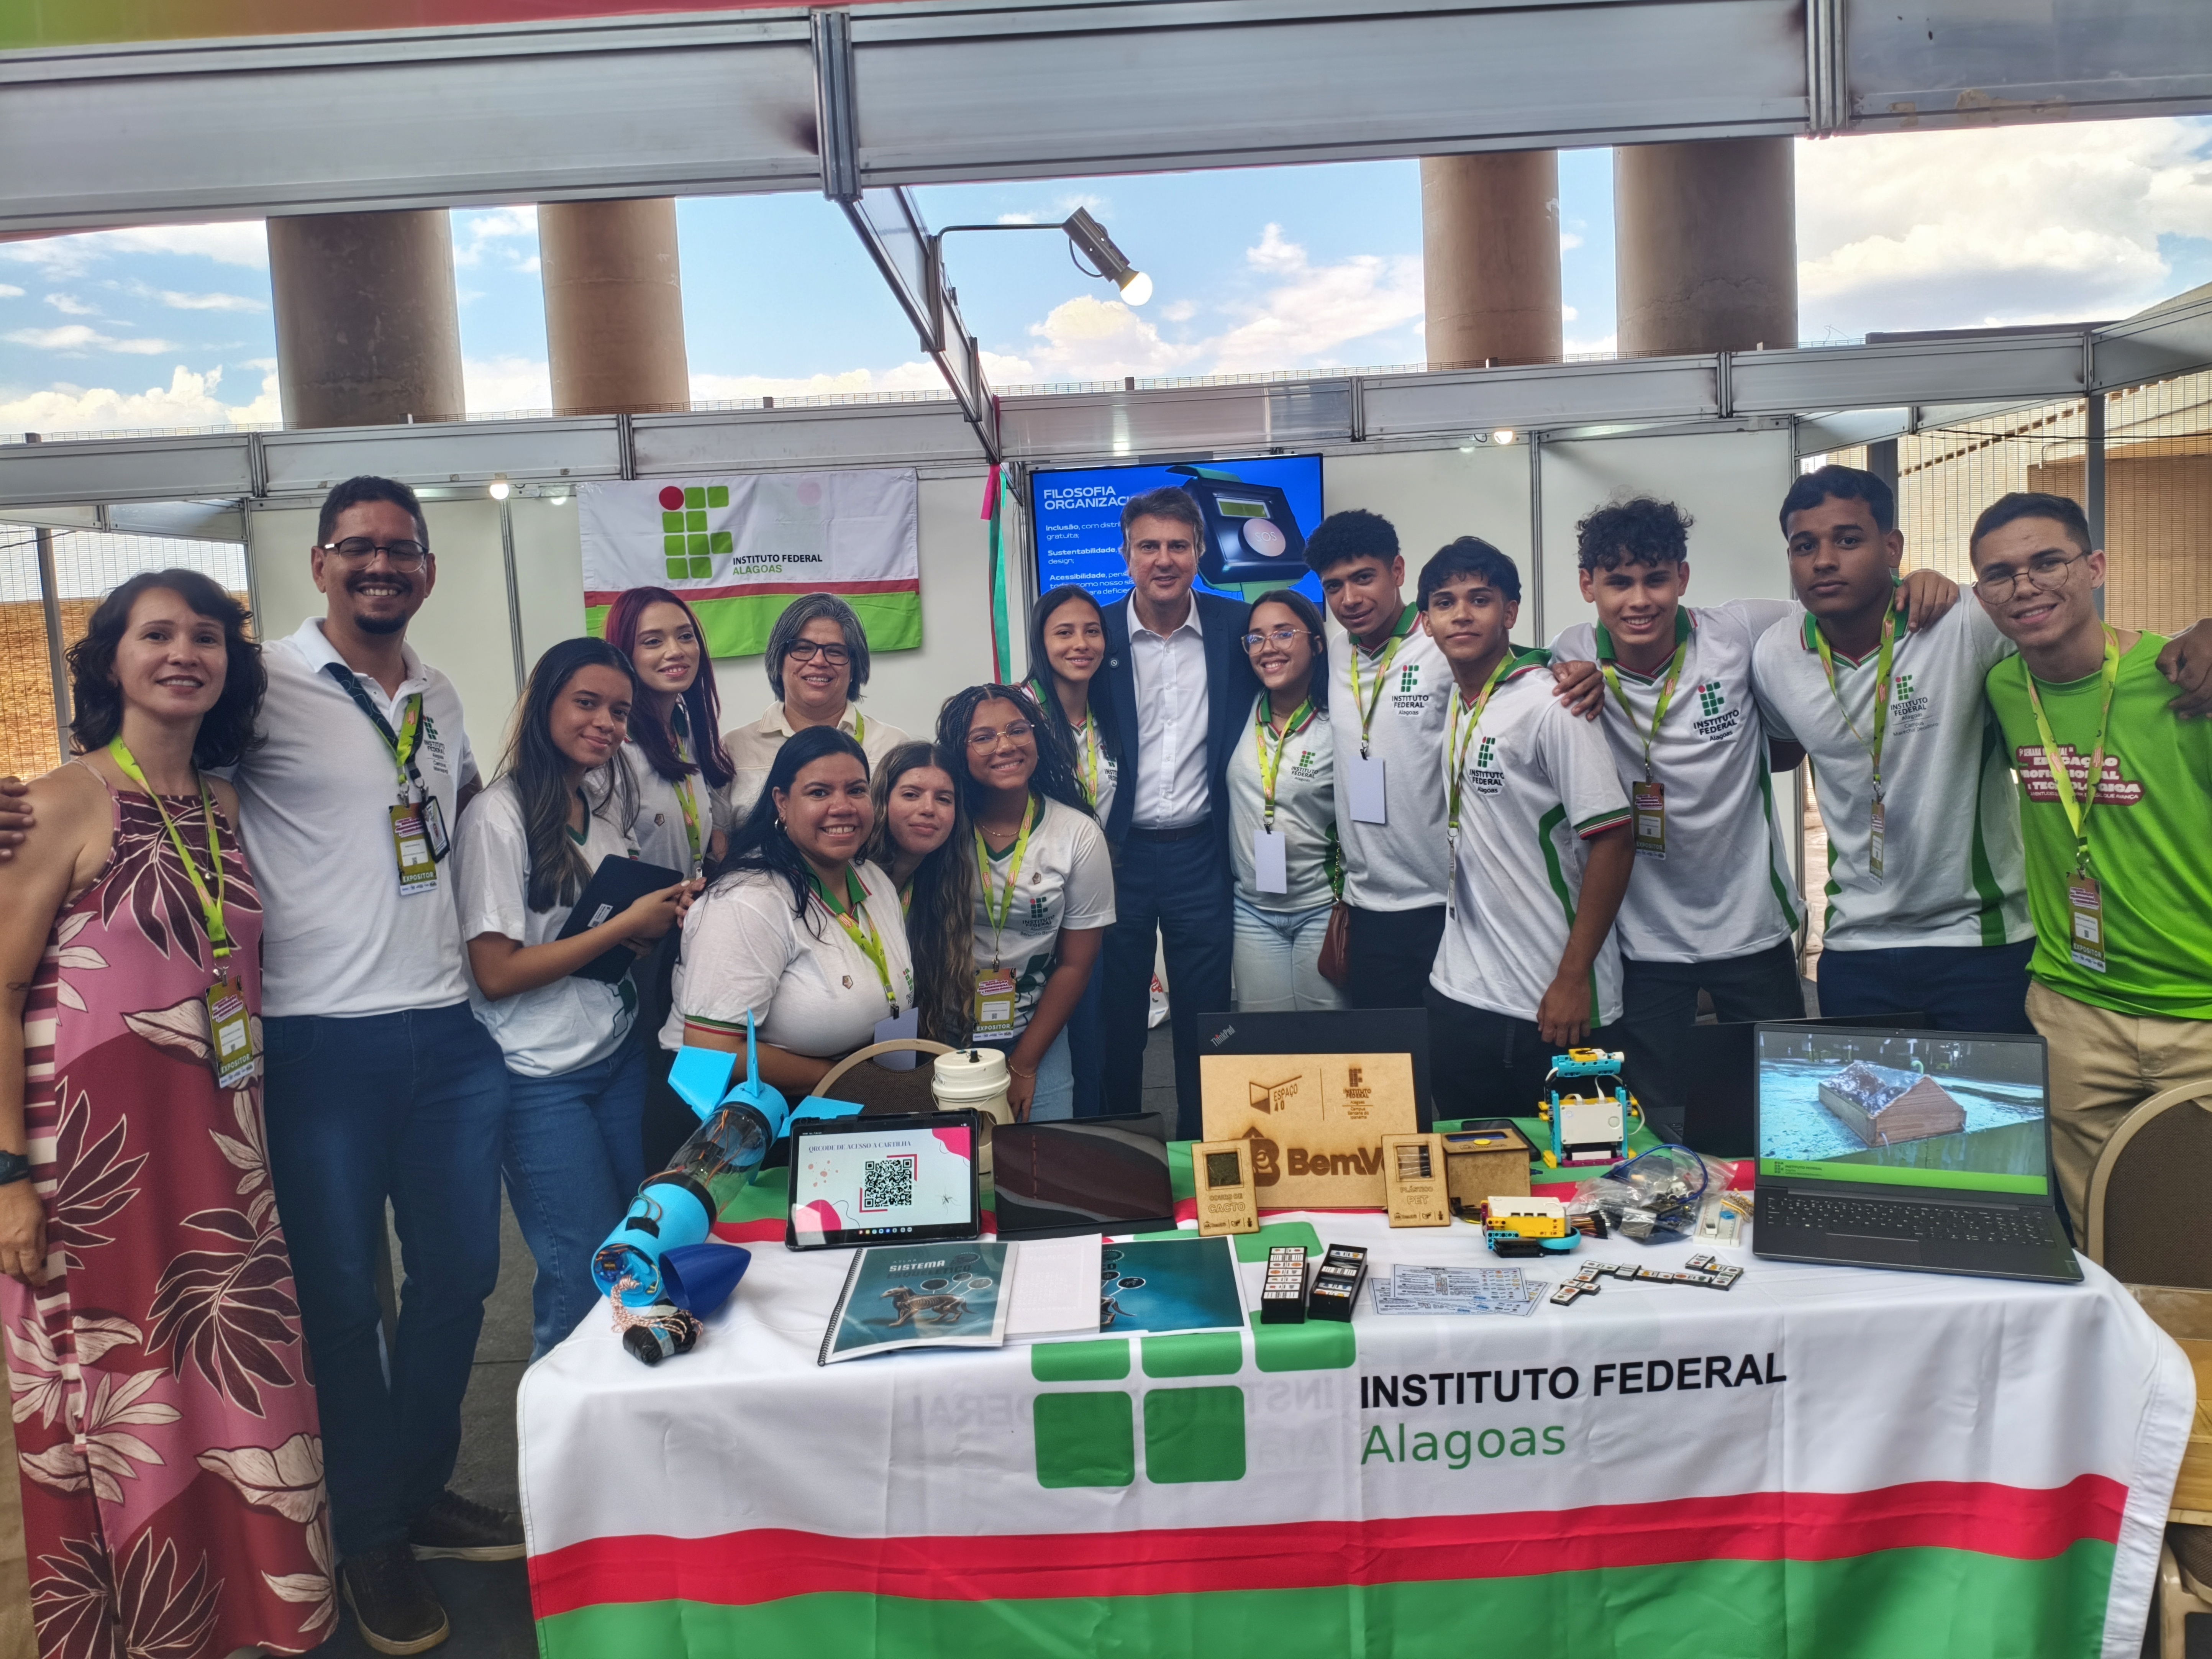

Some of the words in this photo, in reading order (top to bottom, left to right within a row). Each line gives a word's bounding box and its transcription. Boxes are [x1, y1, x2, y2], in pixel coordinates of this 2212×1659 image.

[1044, 486, 1116, 499] FILOSOFIA
[1255, 532, 1277, 542] SOS
[1048, 547, 1117, 556] Sustentabilidade,
[733, 554, 780, 565] INSTITUTO
[733, 565, 782, 575] ALAGOAS
[1049, 572, 1107, 581] Acessibilidade,
[1891, 697, 1928, 710] INSTITUTO
[1894, 704, 1927, 716] FEDERAL
[1694, 710, 1739, 729] INSTITUTO
[1699, 719, 1737, 735] FEDERAL
[1710, 730, 1733, 741] Alagoas
[424, 739, 445, 749] INSTITUTO
[427, 746, 445, 755] FEDERAL
[2024, 748, 2041, 756] SEMANA
[2033, 756, 2118, 768] EDCAÇO
[1469, 769, 1504, 779] INSTITUTO
[1472, 777, 1502, 786] FEDERAL
[403, 872, 434, 883] EXPOSITOR
[1022, 915, 1055, 924] INSTITUTO
[2073, 943, 2101, 957] EXPOSITOR
[1210, 1025, 1235, 1047] ThinkPad
[221, 1054, 250, 1074] EXPOSITOR
[1274, 1084, 1298, 1102] ESPAÇO
[808, 1144, 836, 1152] QRCODE
[1287, 1148, 1384, 1175] BemV
[1407, 1195, 1428, 1205] PET
[1208, 1202, 1245, 1213] CACTO
[889, 1260, 945, 1272] SISTEMA
[1361, 1366, 1579, 1408] INSTITUTO
[1594, 1352, 1787, 1397] FEDERAL
[1361, 1423, 1566, 1470] Alagoas
